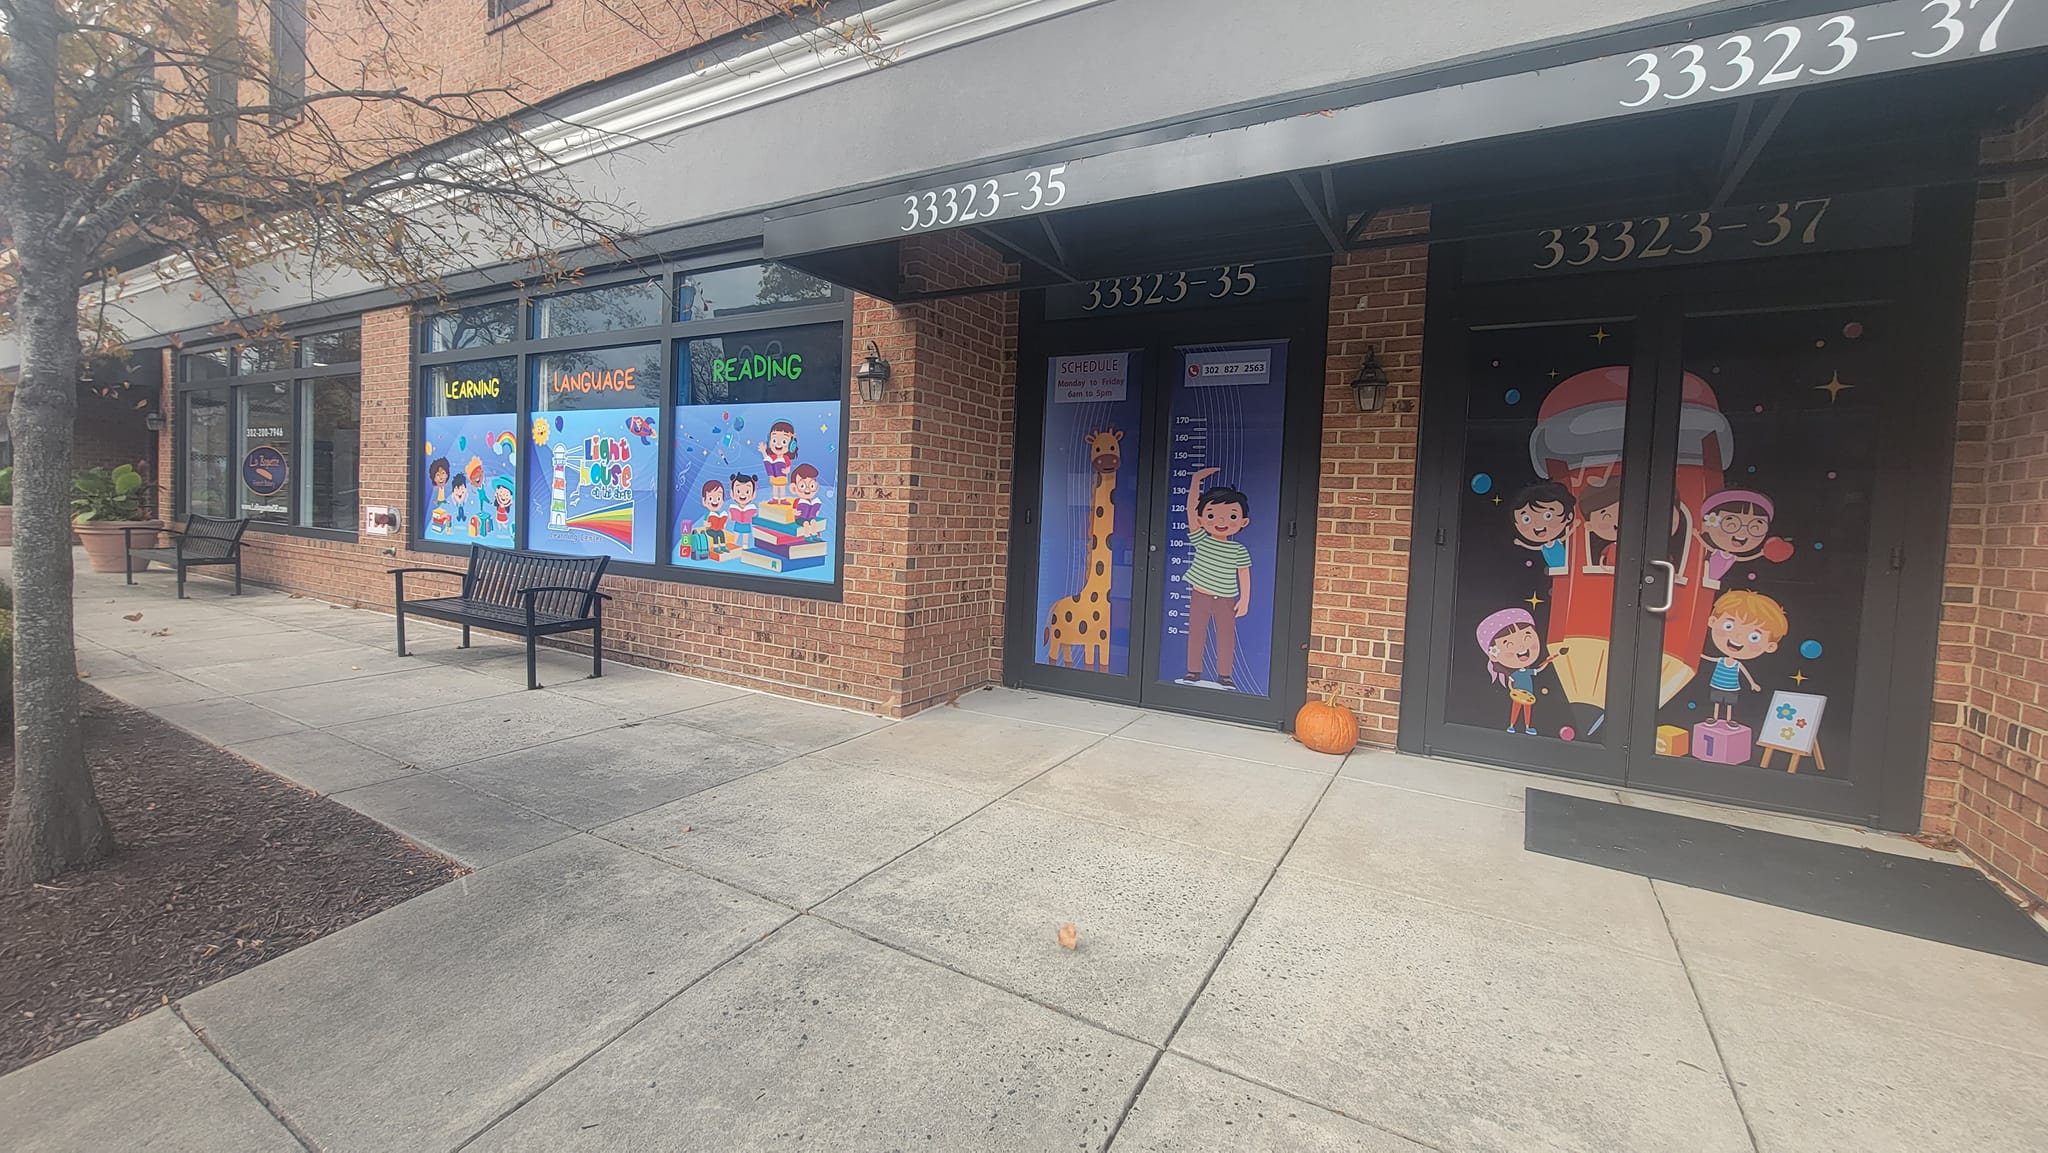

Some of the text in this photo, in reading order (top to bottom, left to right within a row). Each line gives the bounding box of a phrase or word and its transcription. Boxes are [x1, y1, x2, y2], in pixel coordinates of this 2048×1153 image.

[1618, 0, 2016, 108] 33323-37
[900, 163, 1067, 232] 33323-35
[1532, 196, 1832, 270] 33323-37
[1081, 263, 1257, 311] 33323-35
[712, 353, 803, 383] READING
[1061, 359, 1119, 374] SCHEDULE
[1204, 363, 1265, 375] 302 827 2563
[552, 366, 637, 394] LANGUAGE
[1057, 376, 1125, 389] Monday to Friday
[445, 377, 501, 400] LEARNING
[1067, 389, 1113, 399] 6am to 5pm
[1176, 416, 1190, 424] 170
[1175, 434, 1189, 442] 160
[584, 436, 631, 466] Light
[580, 459, 632, 488] house
[1173, 469, 1187, 477] 140
[1173, 487, 1187, 495] 130
[1171, 504, 1185, 512] 120
[1172, 522, 1186, 530] 110
[1171, 557, 1181, 565] 90
[1169, 592, 1180, 600] 70
[1703, 734, 1715, 757] 1
